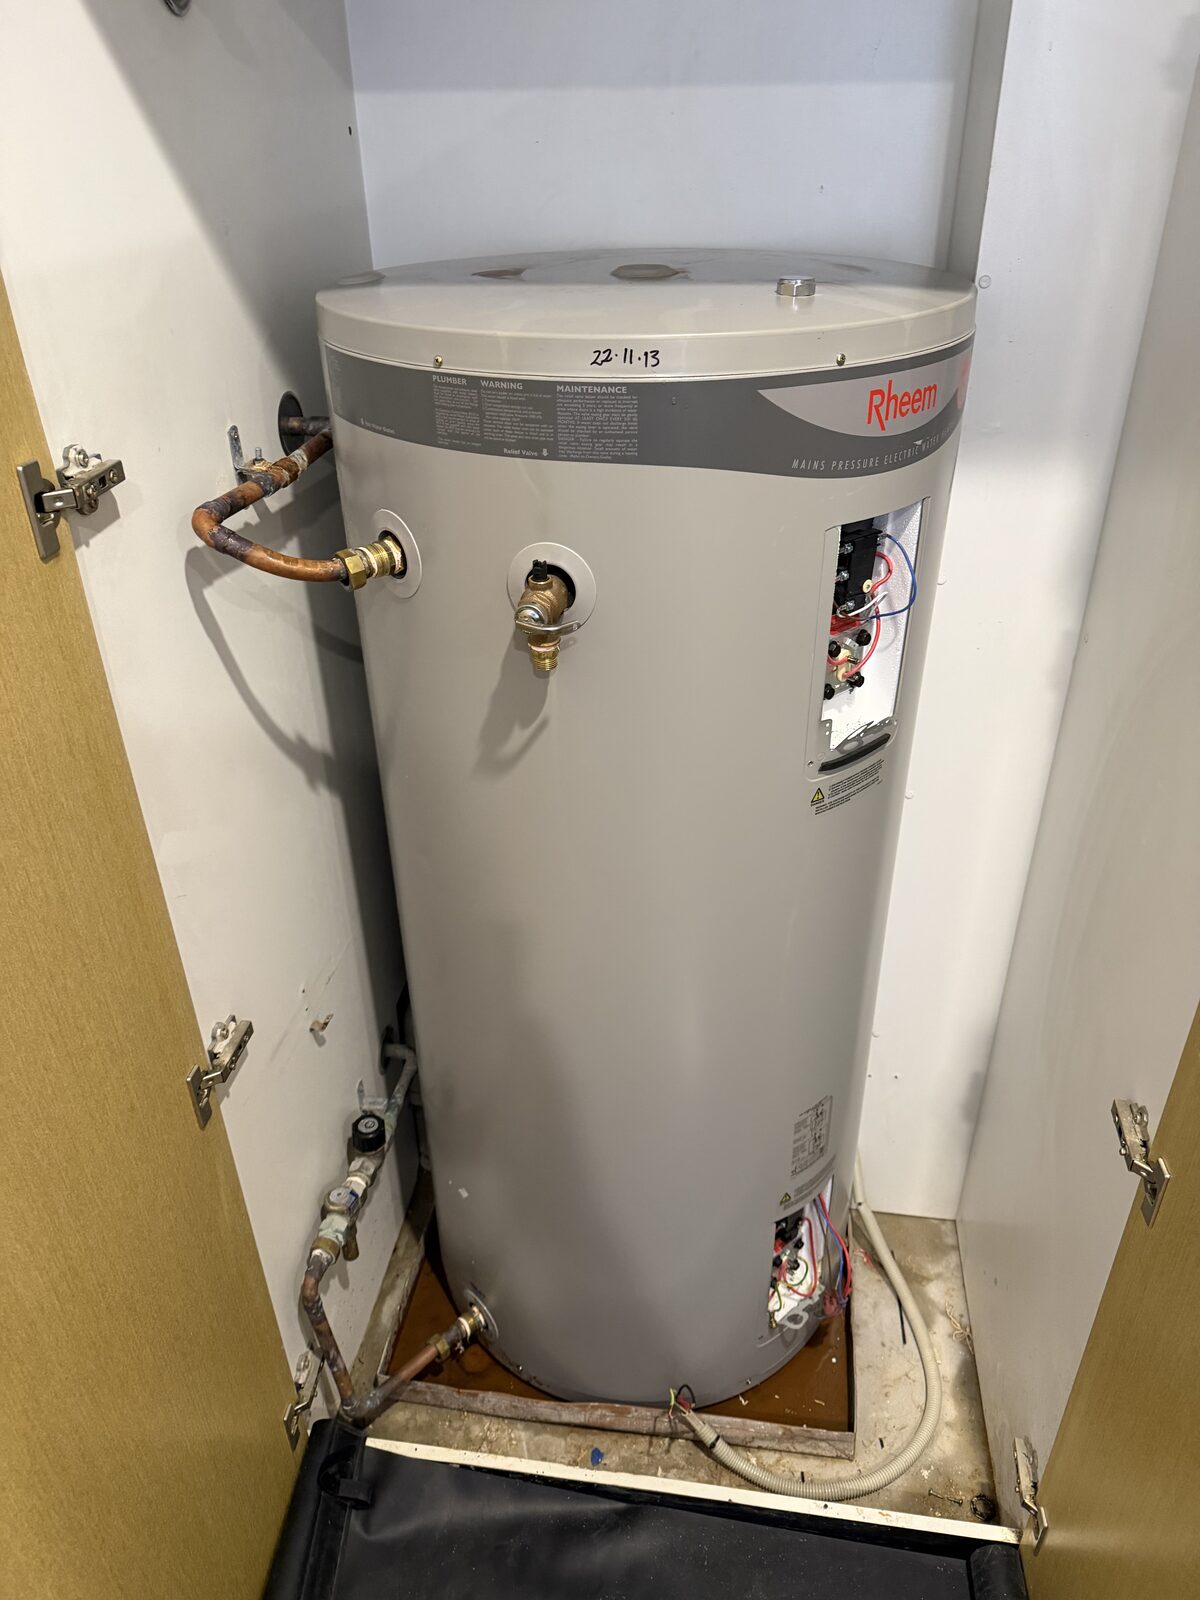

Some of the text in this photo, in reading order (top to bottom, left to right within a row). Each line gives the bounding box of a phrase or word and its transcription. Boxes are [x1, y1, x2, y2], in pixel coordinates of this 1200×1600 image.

[432, 375, 467, 386] PLUMBER
[480, 380, 523, 390] WARNING
[556, 384, 627, 394] MAINTENANCE
[867, 379, 938, 431] Rheem
[503, 447, 538, 457] Relief Valve
[791, 458, 826, 470] MAINS
[831, 456, 880, 471] PRESSURE
[883, 445, 919, 465] ELECTRIC
